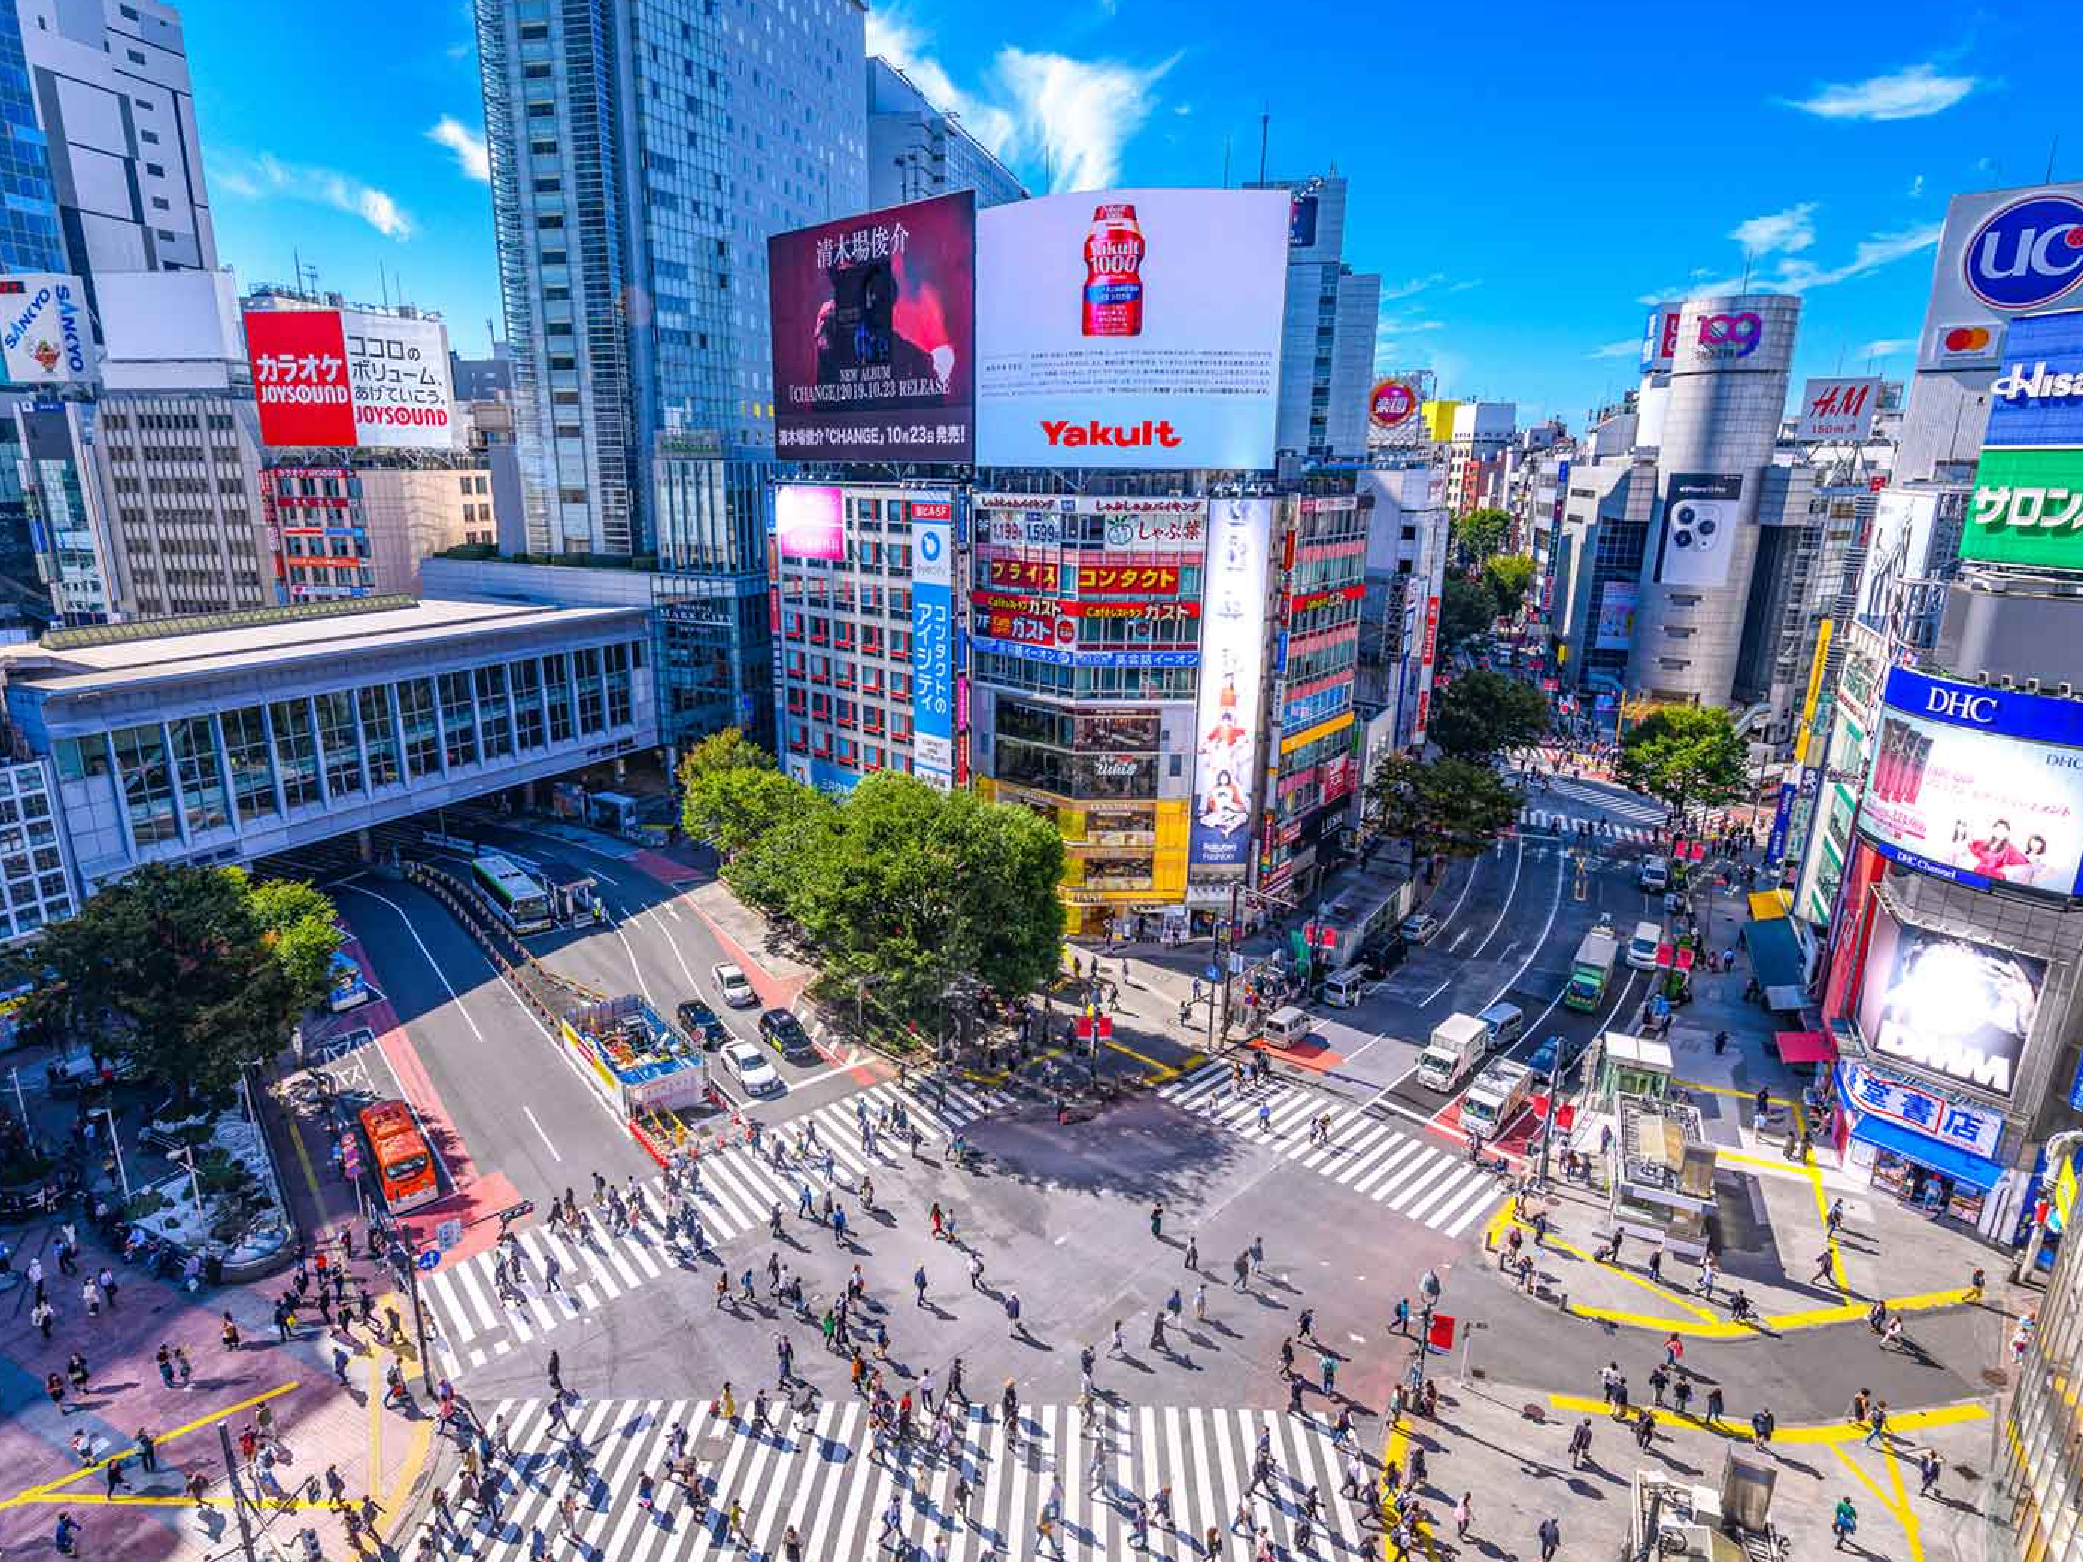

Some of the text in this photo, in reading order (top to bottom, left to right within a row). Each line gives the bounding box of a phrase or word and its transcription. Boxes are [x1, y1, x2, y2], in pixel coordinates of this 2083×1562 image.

[5, 287, 50, 349] SANKYO
[55, 284, 83, 373] SANKYO
[347, 336, 421, 362] ココロの
[1697, 312, 1761, 358] 109
[256, 353, 342, 383] カラオケ
[261, 384, 349, 404] JOYSOUND
[1809, 385, 1869, 419] H&M
[356, 405, 448, 426] JOYSOUND
[1041, 421, 1182, 447] Yakult
[1974, 485, 2083, 529] サロン
[992, 562, 1056, 585] プライス
[1079, 568, 1176, 588] コンタクト
[1011, 616, 1052, 641] ガスト
[916, 602, 932, 710] アイシティ
[935, 605, 947, 715] コンタクトの
[1926, 687, 1998, 723] DHC
